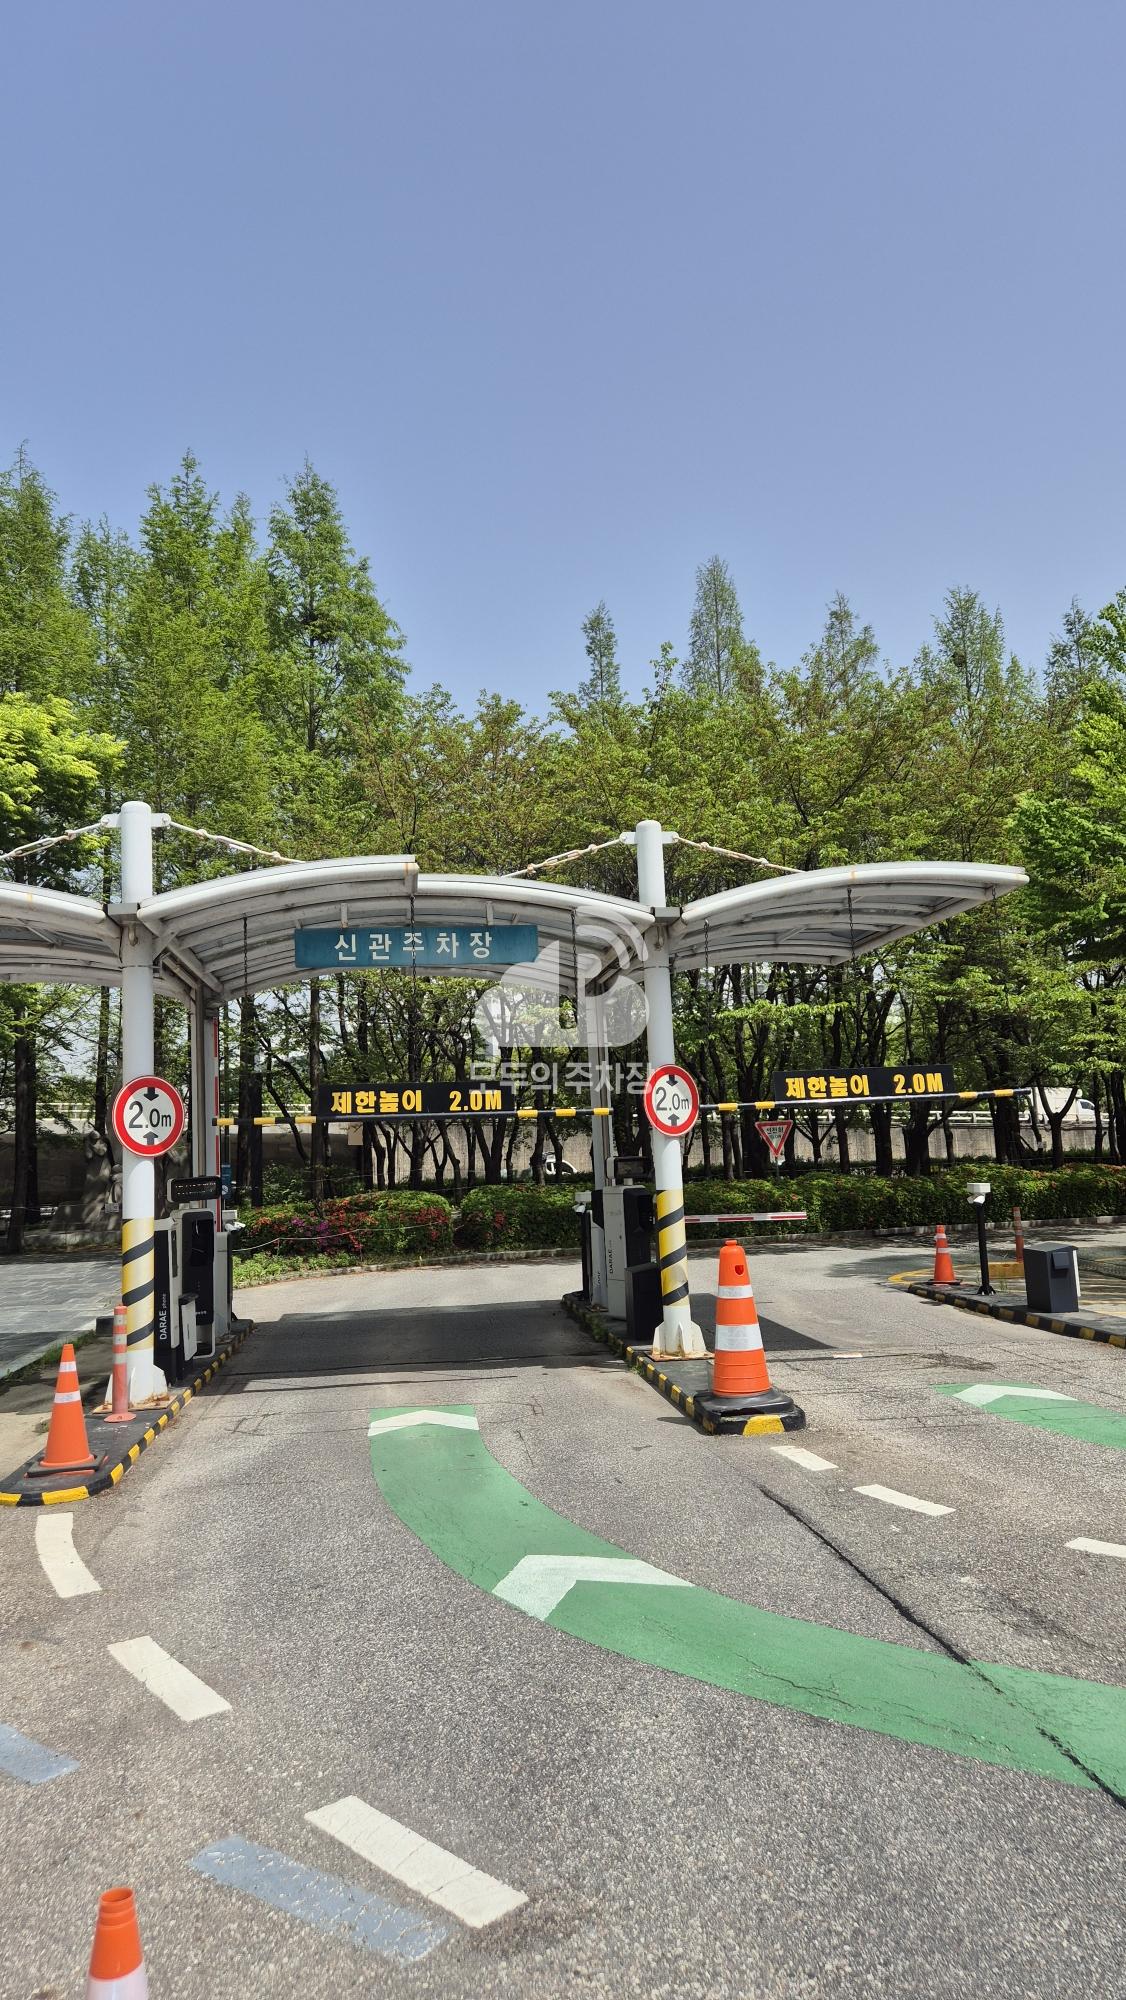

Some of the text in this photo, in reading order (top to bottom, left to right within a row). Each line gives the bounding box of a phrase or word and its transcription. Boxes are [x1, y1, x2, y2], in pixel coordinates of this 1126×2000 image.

[334, 931, 492, 961] 신관주차장
[655, 1086, 690, 1112] 2.0m
[785, 1072, 944, 1099] 제한높이 2.0M
[128, 1100, 172, 1128] 2.0m
[331, 1089, 502, 1114] 제한높이 2.0M
[159, 1309, 168, 1341] DARAE
